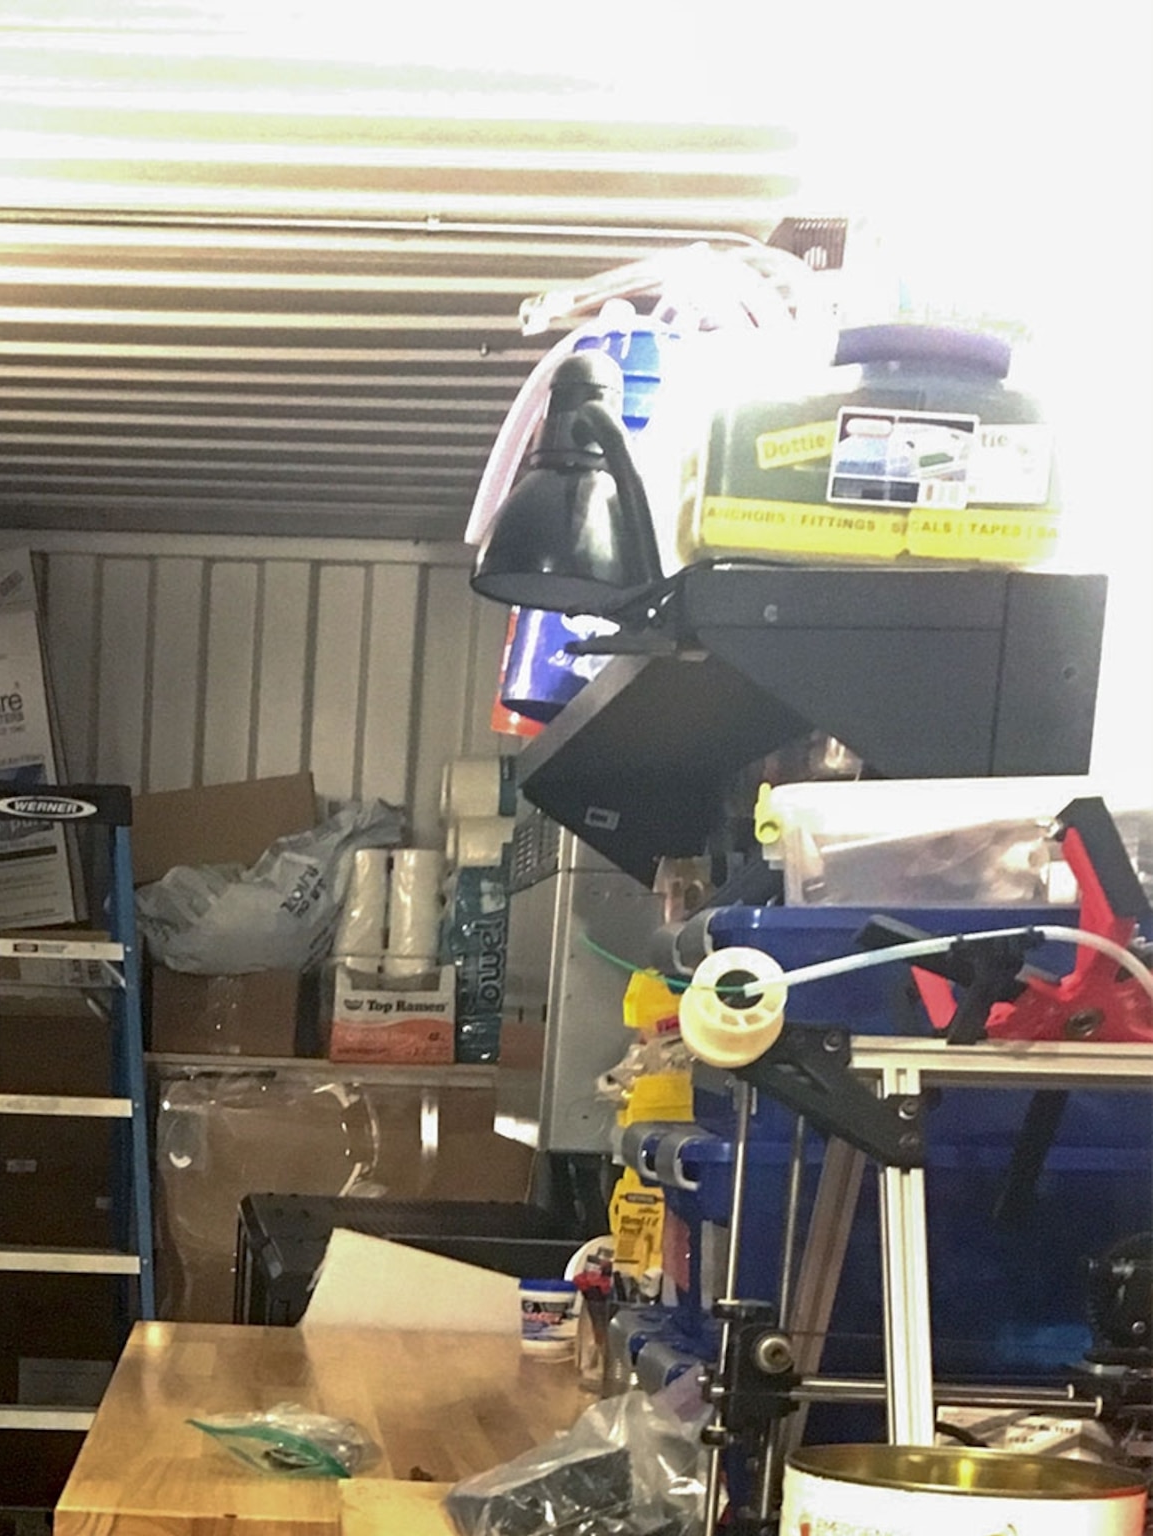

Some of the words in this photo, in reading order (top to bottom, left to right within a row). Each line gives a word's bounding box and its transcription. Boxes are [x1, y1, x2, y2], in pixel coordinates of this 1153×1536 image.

[799, 513, 877, 532] FITTINGS
[13, 798, 79, 815] WERNER
[365, 999, 394, 1015] Top
[395, 998, 447, 1013] Ramen
